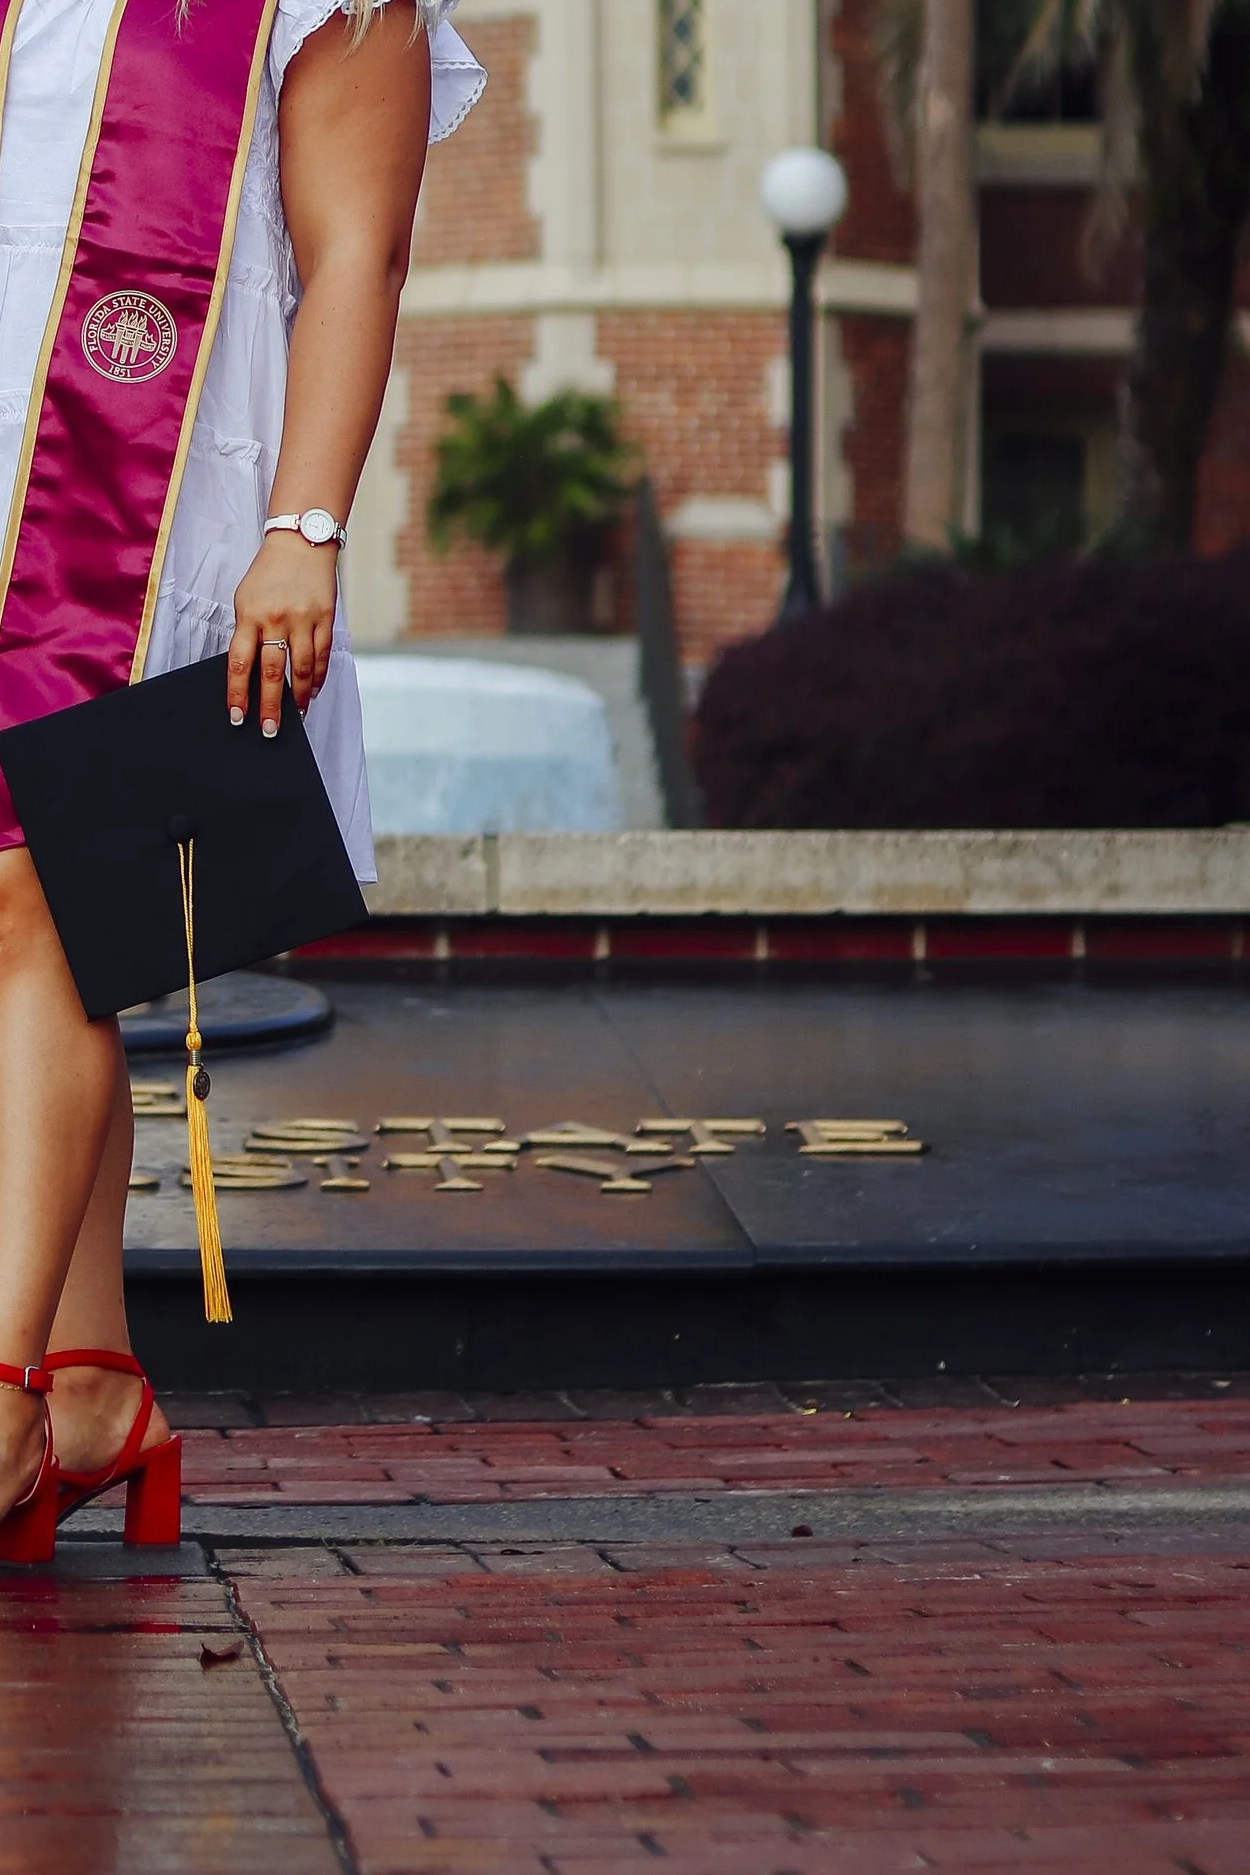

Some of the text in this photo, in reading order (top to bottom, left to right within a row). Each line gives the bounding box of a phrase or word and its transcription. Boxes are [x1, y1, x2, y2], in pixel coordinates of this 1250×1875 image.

[87, 296, 171, 369] FLORIDA STATE UNIVERSITY
[108, 365, 131, 377] 1851
[244, 1117, 930, 1155] STATE
